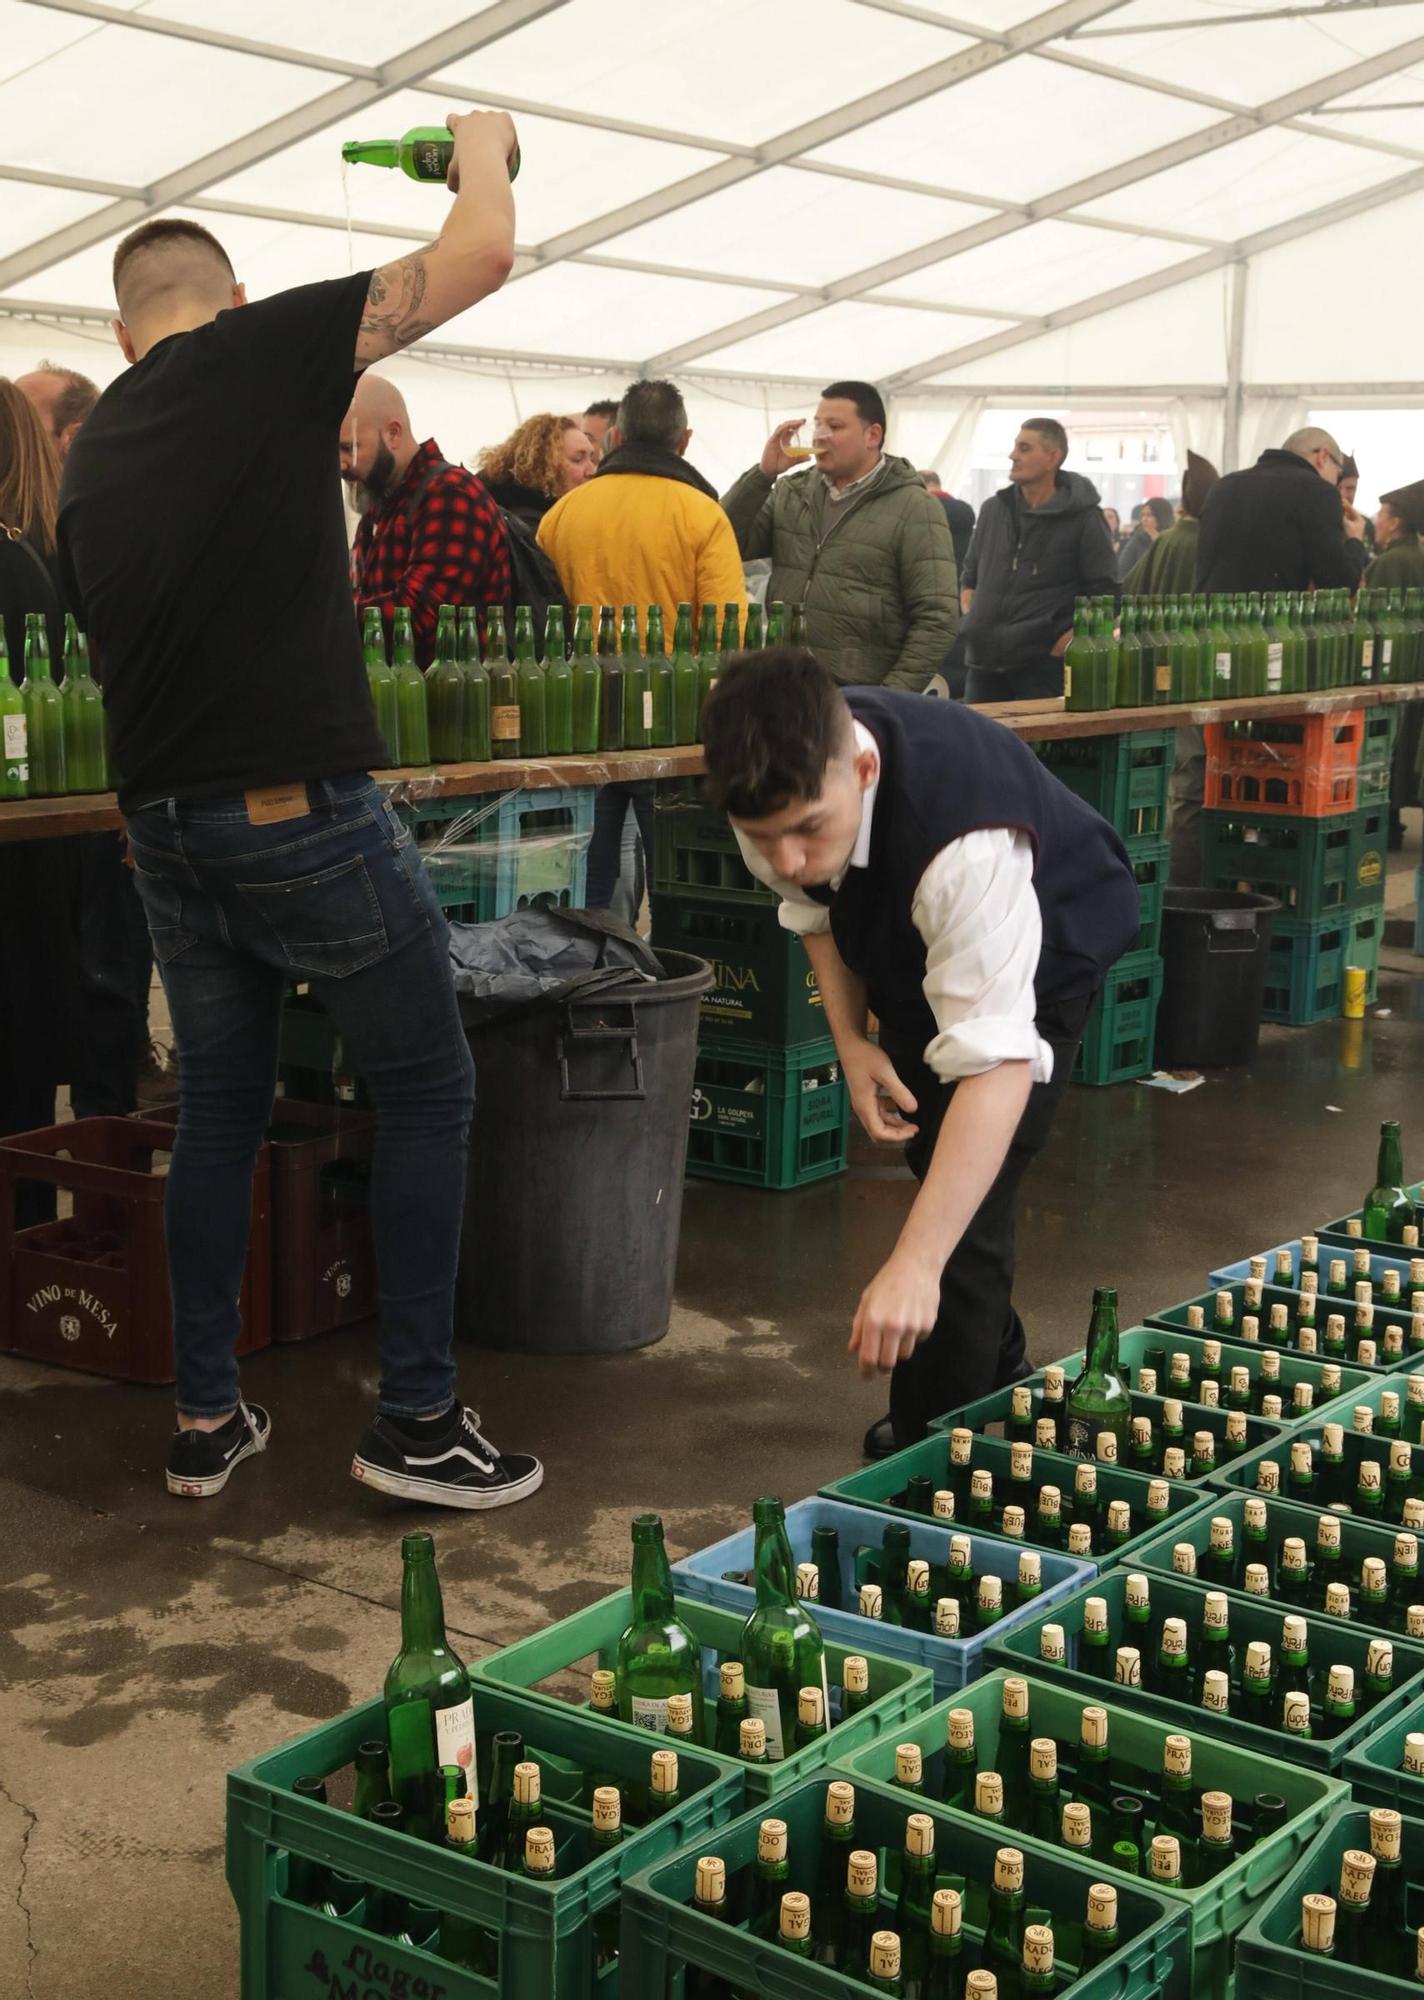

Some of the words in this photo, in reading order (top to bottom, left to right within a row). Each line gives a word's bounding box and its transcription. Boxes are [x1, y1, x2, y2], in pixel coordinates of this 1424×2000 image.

[711, 996, 744, 1008] NATURAL
[26, 1284, 62, 1313] VINO
[64, 1288, 76, 1298] DE
[78, 1289, 118, 1339] MESA
